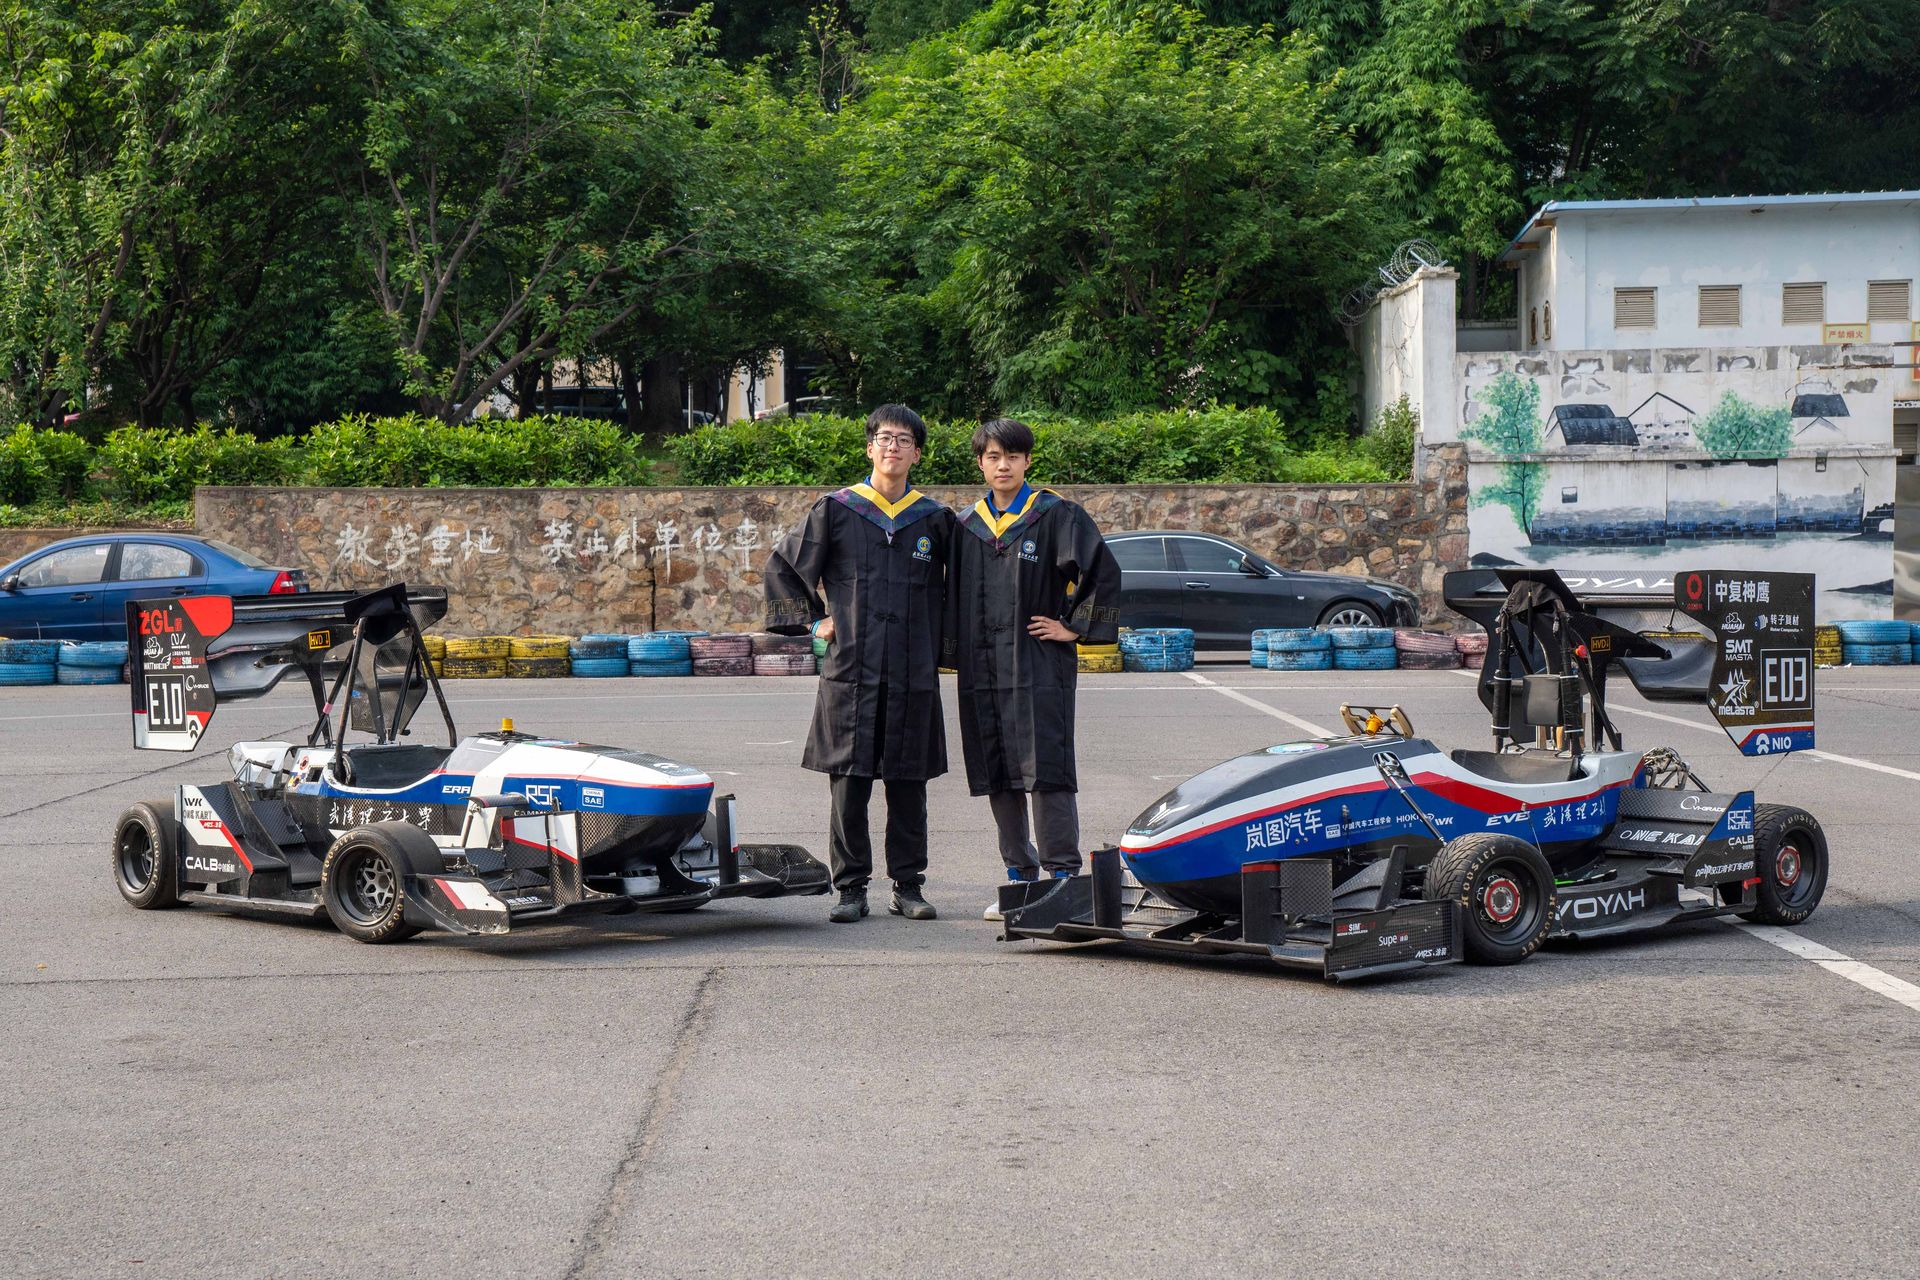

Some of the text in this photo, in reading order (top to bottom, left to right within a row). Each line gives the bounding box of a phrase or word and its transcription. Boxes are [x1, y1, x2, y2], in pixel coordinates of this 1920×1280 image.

[1715, 579, 1770, 603] 中复神鹰
[1721, 623, 1745, 631] HUAHAI
[1726, 639, 1754, 654] SMT
[1772, 736, 1792, 750] NIO
[1486, 810, 1531, 827] EVE
[1246, 808, 1323, 852] 岚图汽车
[1728, 834, 1754, 846] CALB
[185, 856, 218, 871] CALB
